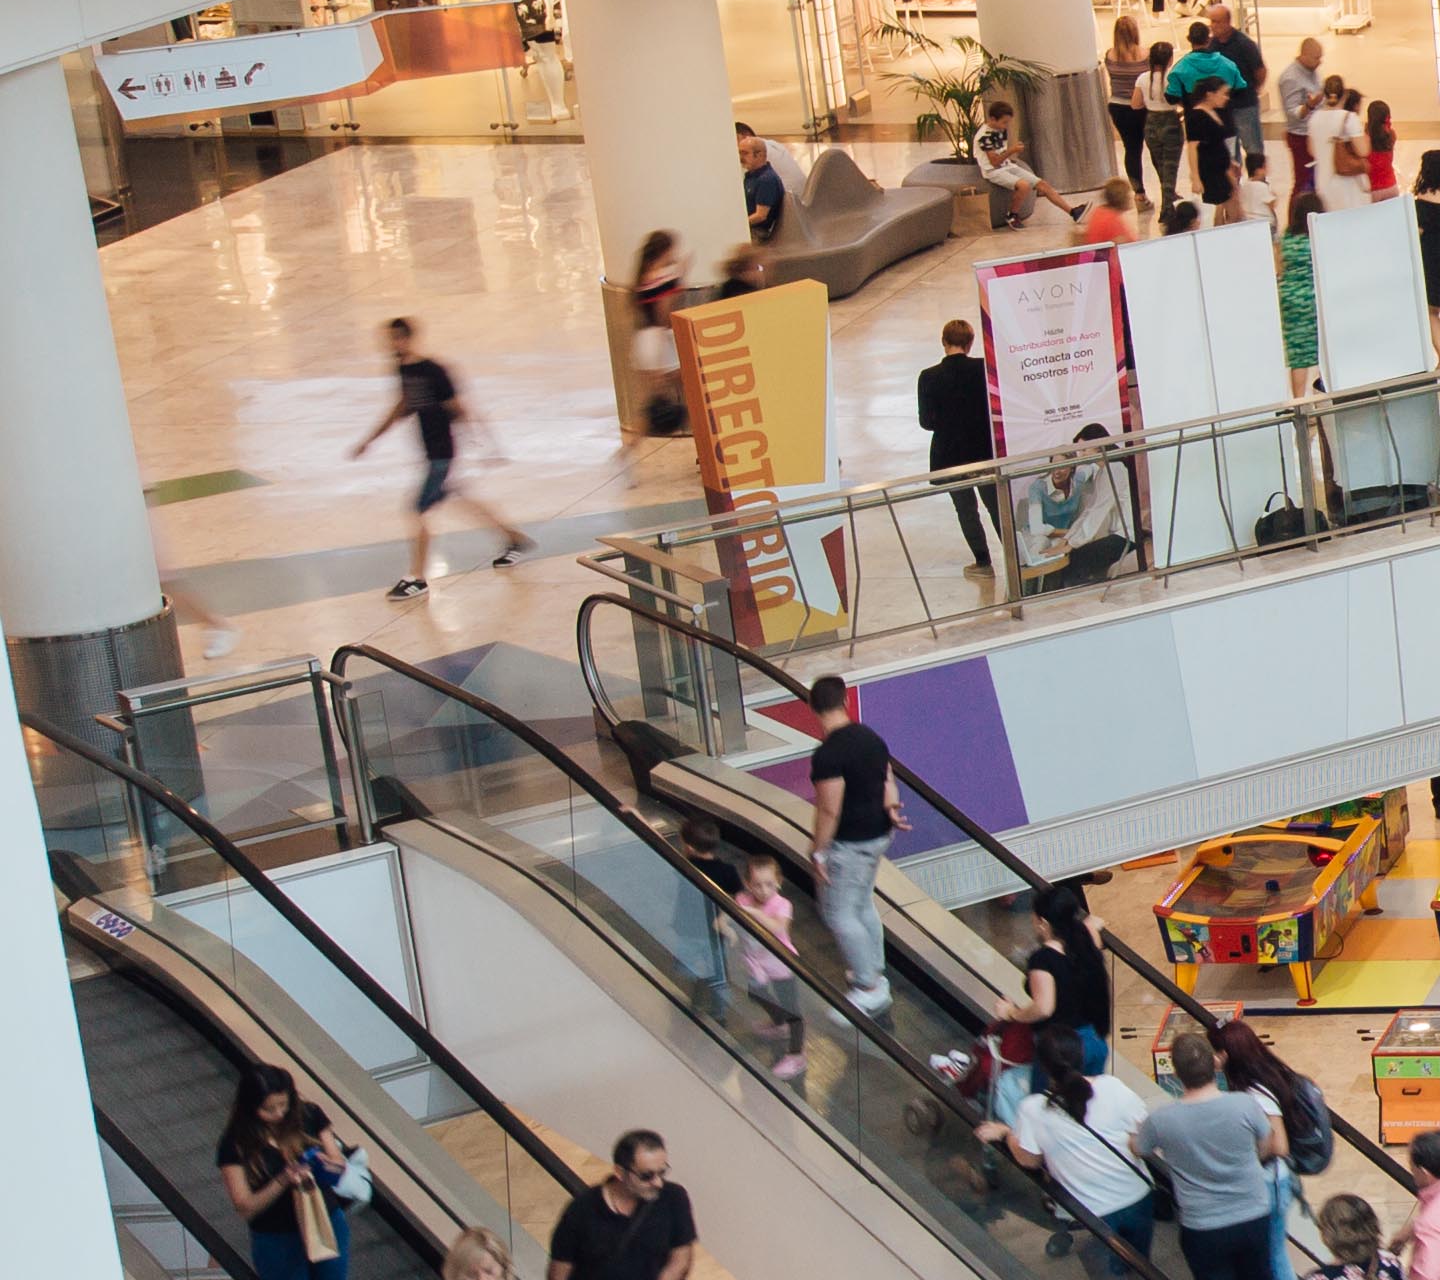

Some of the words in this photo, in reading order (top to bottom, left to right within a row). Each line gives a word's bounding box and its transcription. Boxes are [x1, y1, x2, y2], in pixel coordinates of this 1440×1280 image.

[1017, 282, 1084, 305] AVON
[1009, 338, 1065, 354] Distribuidora
[1066, 335, 1078, 344] de
[1079, 331, 1101, 341] Avon
[1020, 352, 1071, 370] ¡Contacta
[1074, 348, 1094, 360] con
[1023, 367, 1069, 383] nosotros
[1071, 360, 1095, 374] hoy!
[688, 310, 797, 612] DIRECTORIO
